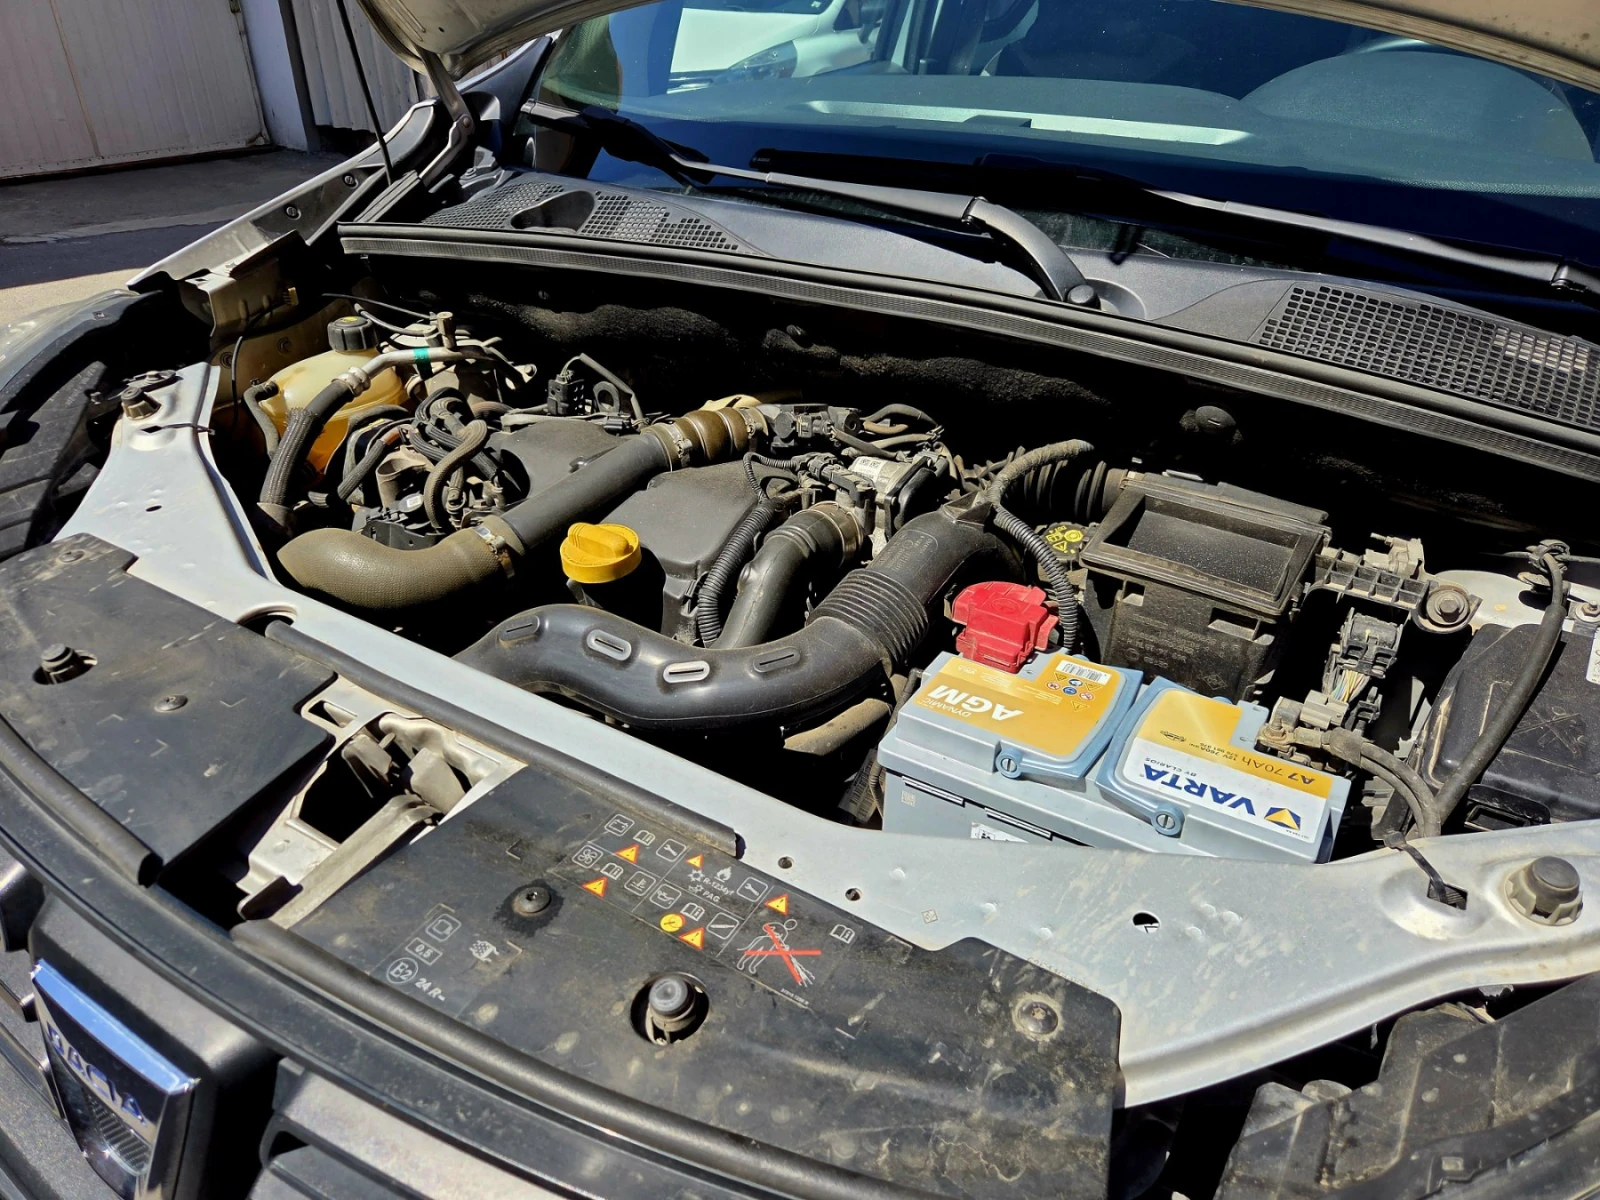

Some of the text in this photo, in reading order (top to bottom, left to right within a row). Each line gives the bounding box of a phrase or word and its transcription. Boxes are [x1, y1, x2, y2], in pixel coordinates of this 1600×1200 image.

[923, 698, 972, 718] DYNAMIC
[927, 684, 1024, 721] AGM
[1145, 757, 1182, 773] CLARIOS
[1241, 756, 1315, 785] A7 70Ah
[1144, 763, 1256, 816] VARTA
[702, 877, 735, 896] R-1234yf
[702, 890, 721, 902] PAG
[415, 977, 432, 991] 24
[47, 1021, 146, 1127] DACIA
